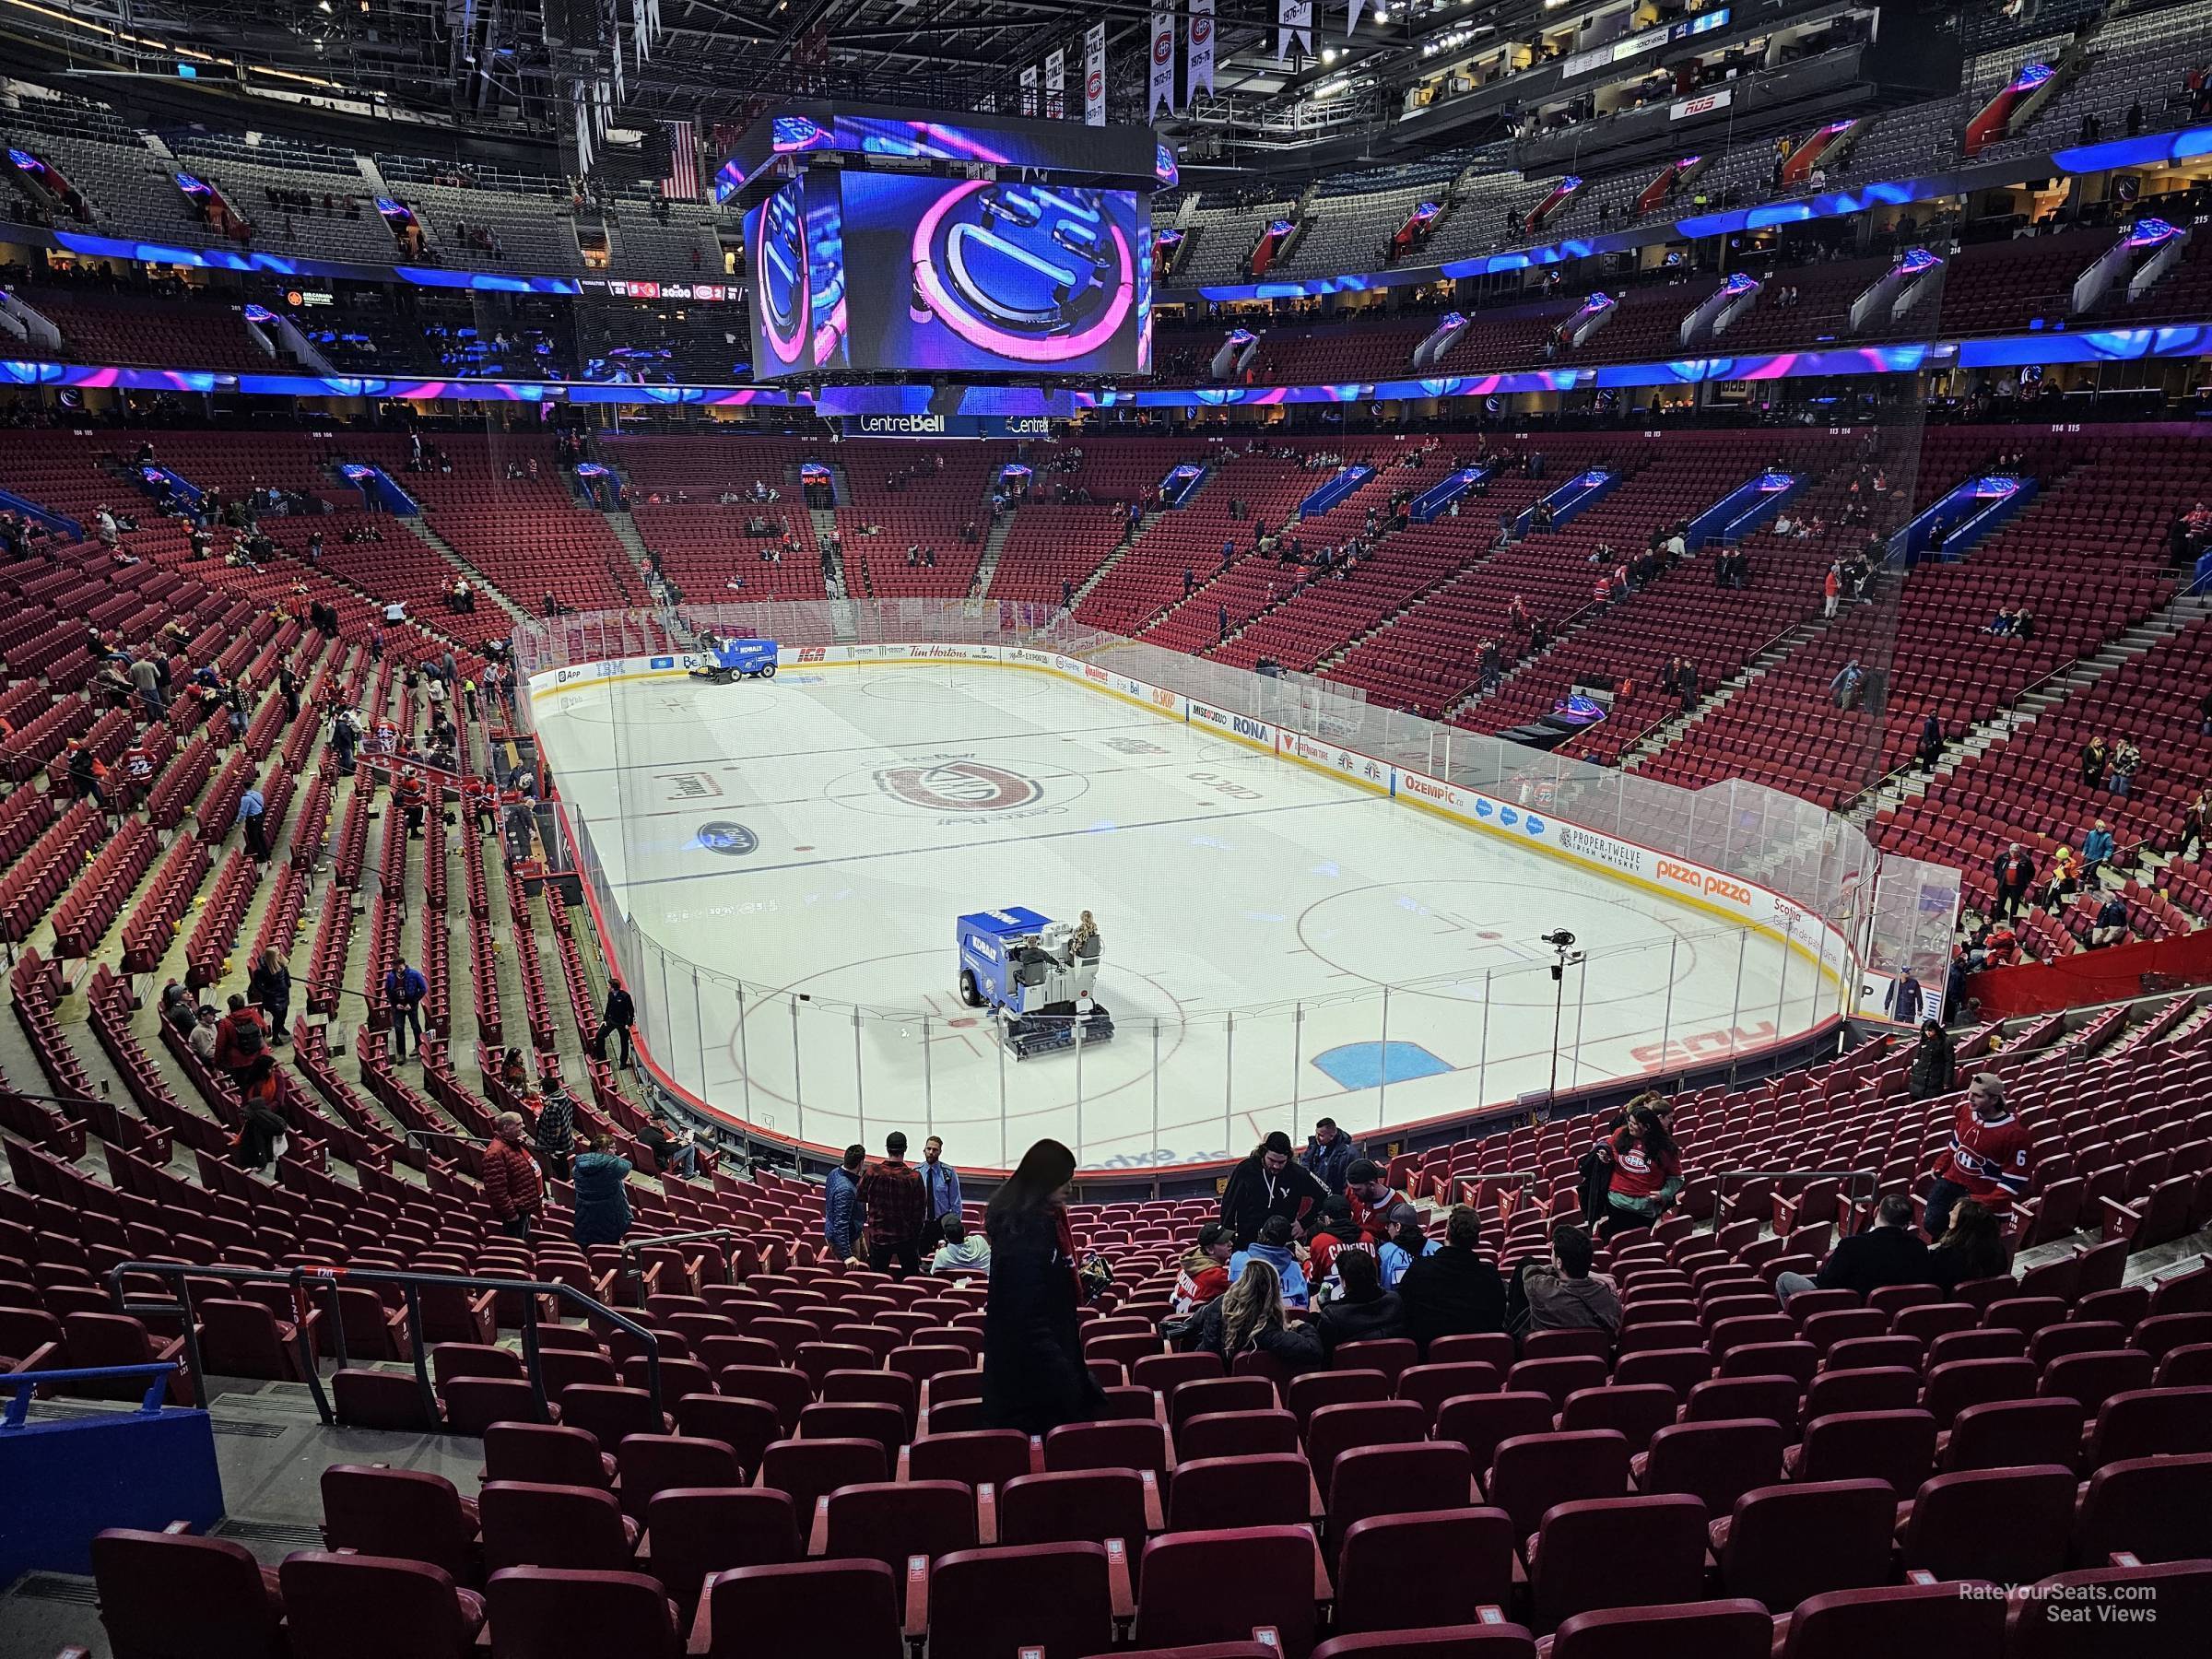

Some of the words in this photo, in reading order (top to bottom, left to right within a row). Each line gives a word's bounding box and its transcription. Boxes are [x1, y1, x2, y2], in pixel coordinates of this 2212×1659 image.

[1283, 2, 1307, 22] 1976-77
[1086, 37, 1103, 58] STANLEY
[1191, 50, 1210, 67] 1975-76
[1153, 69, 1171, 87] 1972-73
[2194, 215, 2208, 225] 215
[2118, 224, 2132, 234] 214
[662, 288, 691, 299] 20:00
[713, 288, 722, 298] 2
[2052, 424, 2064, 432] 114
[2067, 424, 2080, 432] 115
[740, 645, 762, 653] KOBALT
[796, 647, 826, 663] IGA
[909, 645, 927, 657] Tim
[929, 644, 967, 658] Hortons
[1130, 681, 1140, 697] Bell
[1159, 690, 1176, 709] SKIP
[1233, 715, 1269, 743] RONA
[1317, 748, 1329, 761] TIRE
[130, 760, 149, 775] 22
[1570, 841, 1596, 857] IRISH
[1600, 853, 1641, 872] WHISKEY
[1656, 860, 1702, 888] pizza
[1704, 875, 1751, 907] pizza
[1799, 929, 1808, 943] de
[972, 935, 998, 962] KOBALT
[2016, 1149, 2027, 1167] 6
[2010, 1214, 2018, 1224] H
[2113, 1225, 2123, 1233] 119
[317, 1268, 334, 1277] 120
[290, 1294, 300, 1324] 120
[484, 1307, 489, 1318] H
